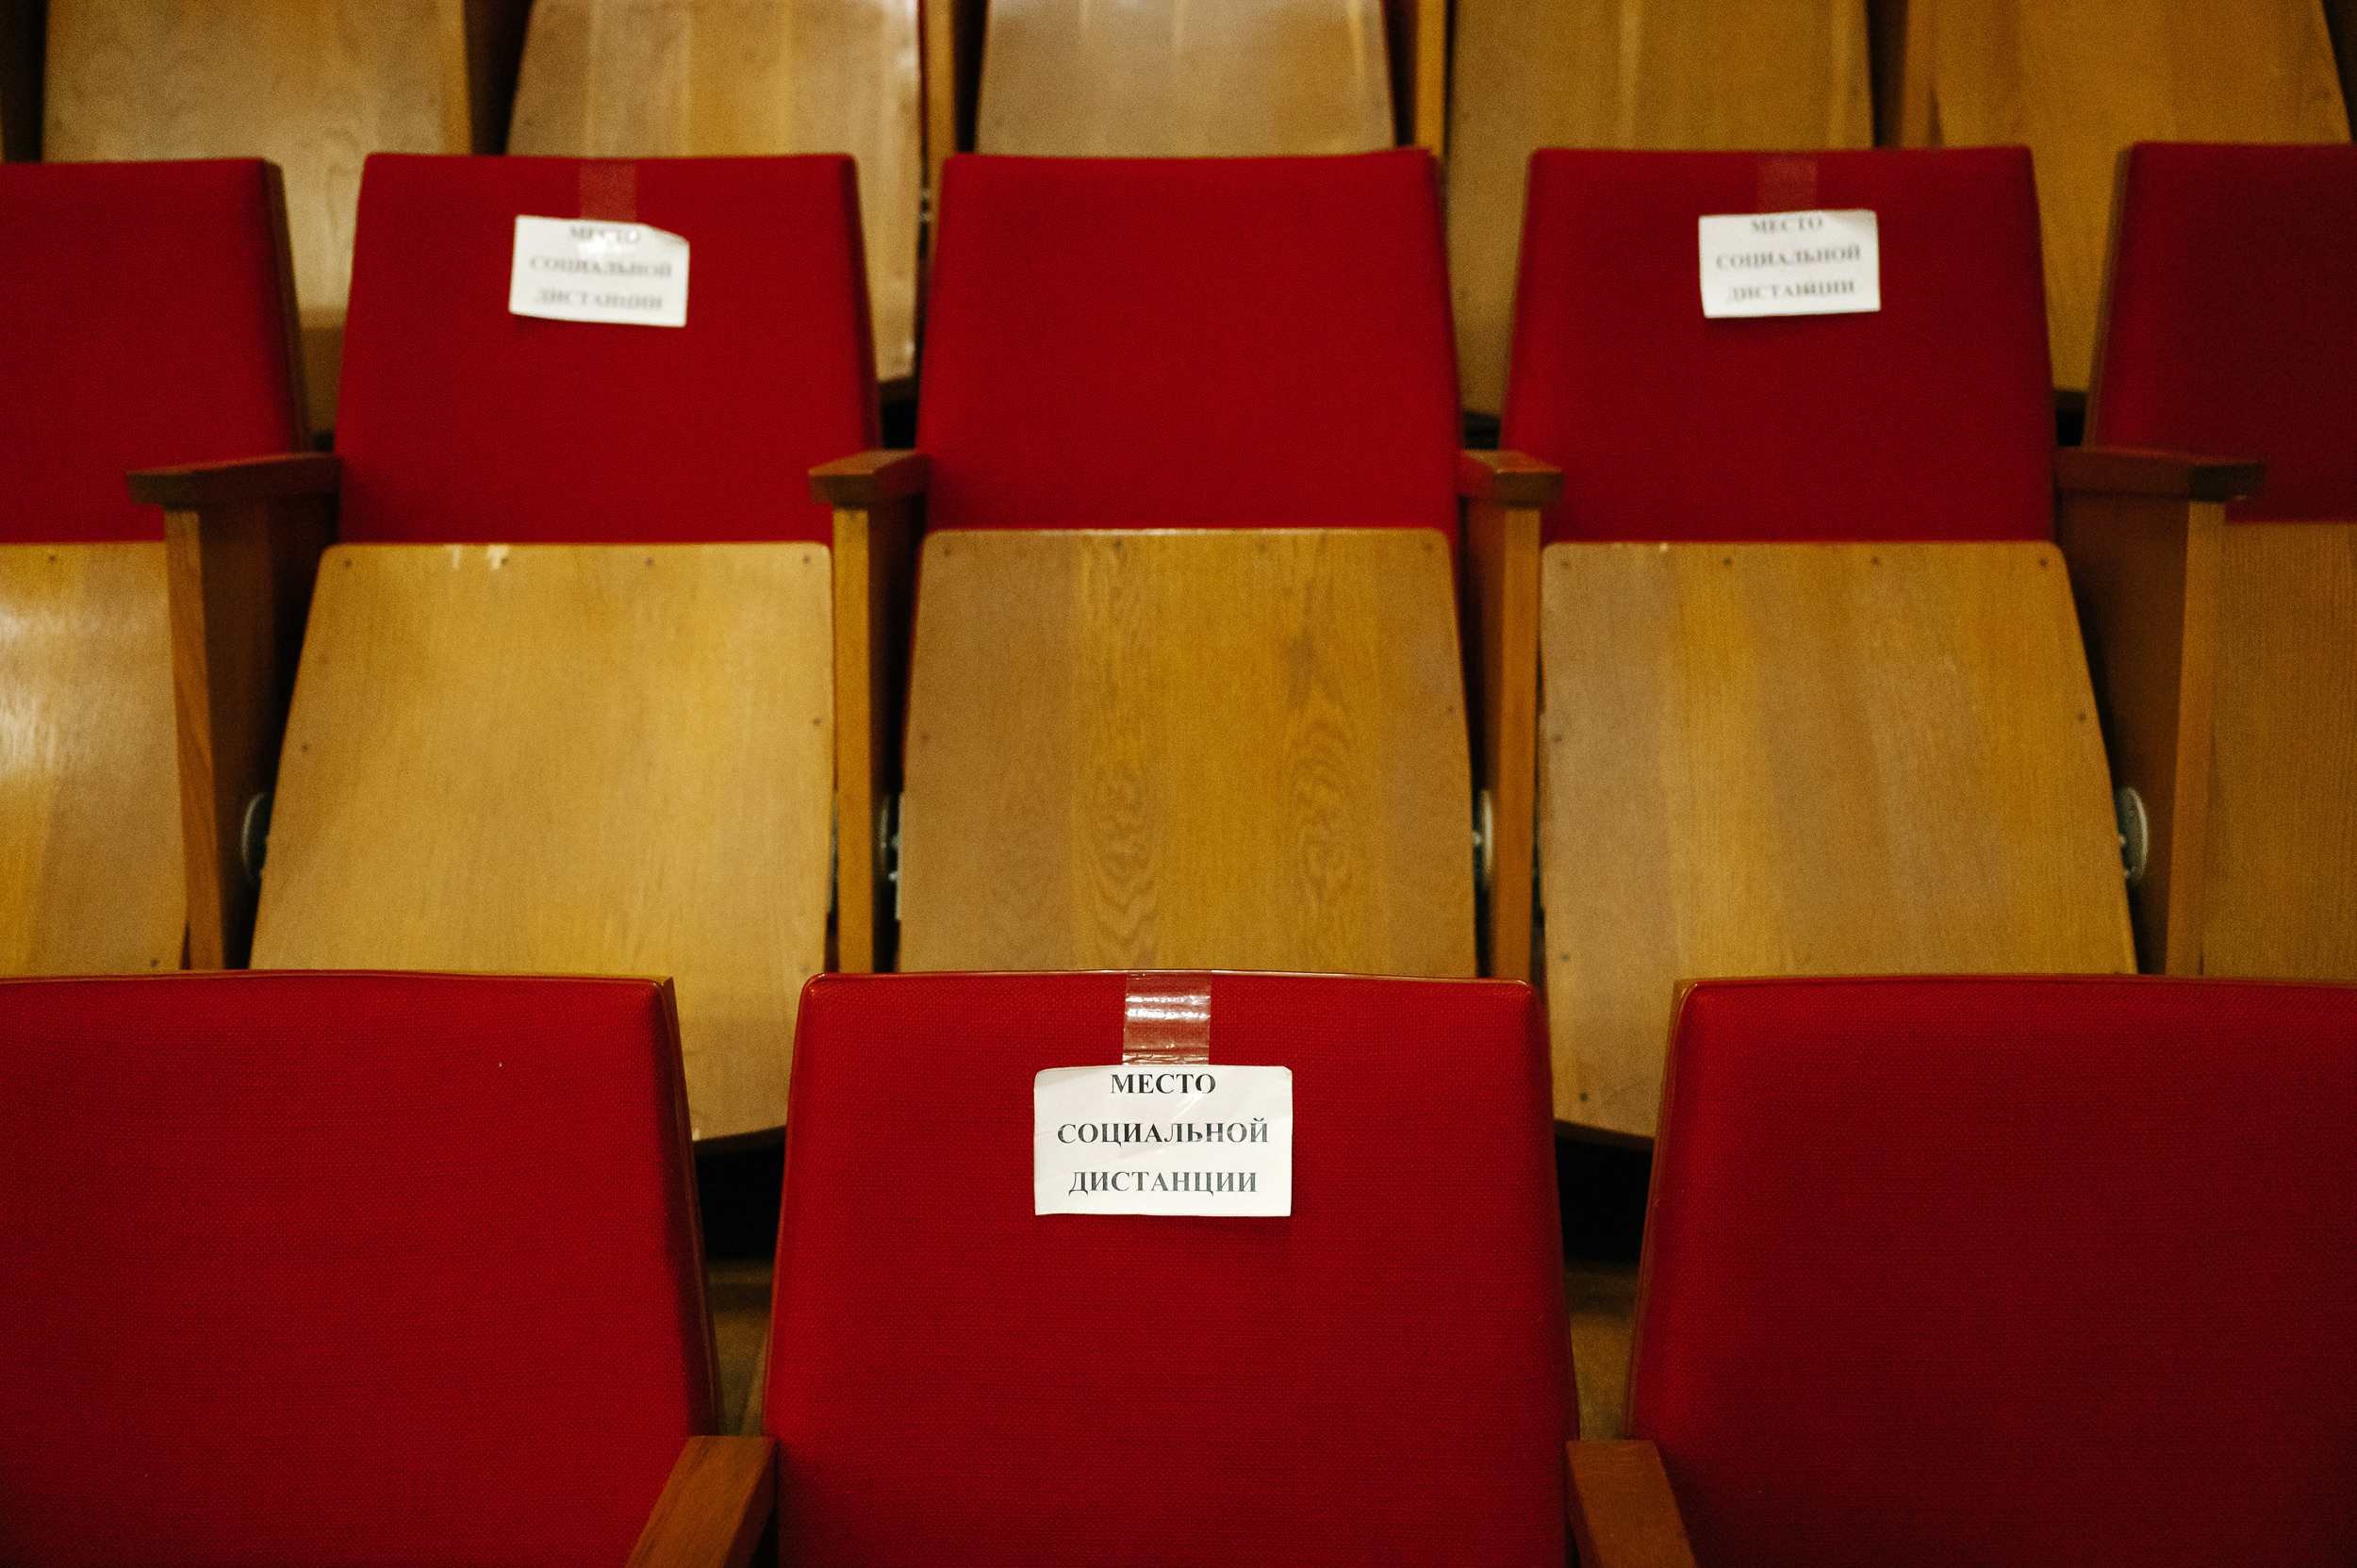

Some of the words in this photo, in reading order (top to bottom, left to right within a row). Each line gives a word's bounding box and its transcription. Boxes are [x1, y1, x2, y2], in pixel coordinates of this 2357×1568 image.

[1110, 1073, 1216, 1094] МЕСТО
[1057, 1116, 1270, 1147] СОЦИАЛЬНОЙ
[1068, 1171, 1258, 1197] ДИСТАНЦИИ
